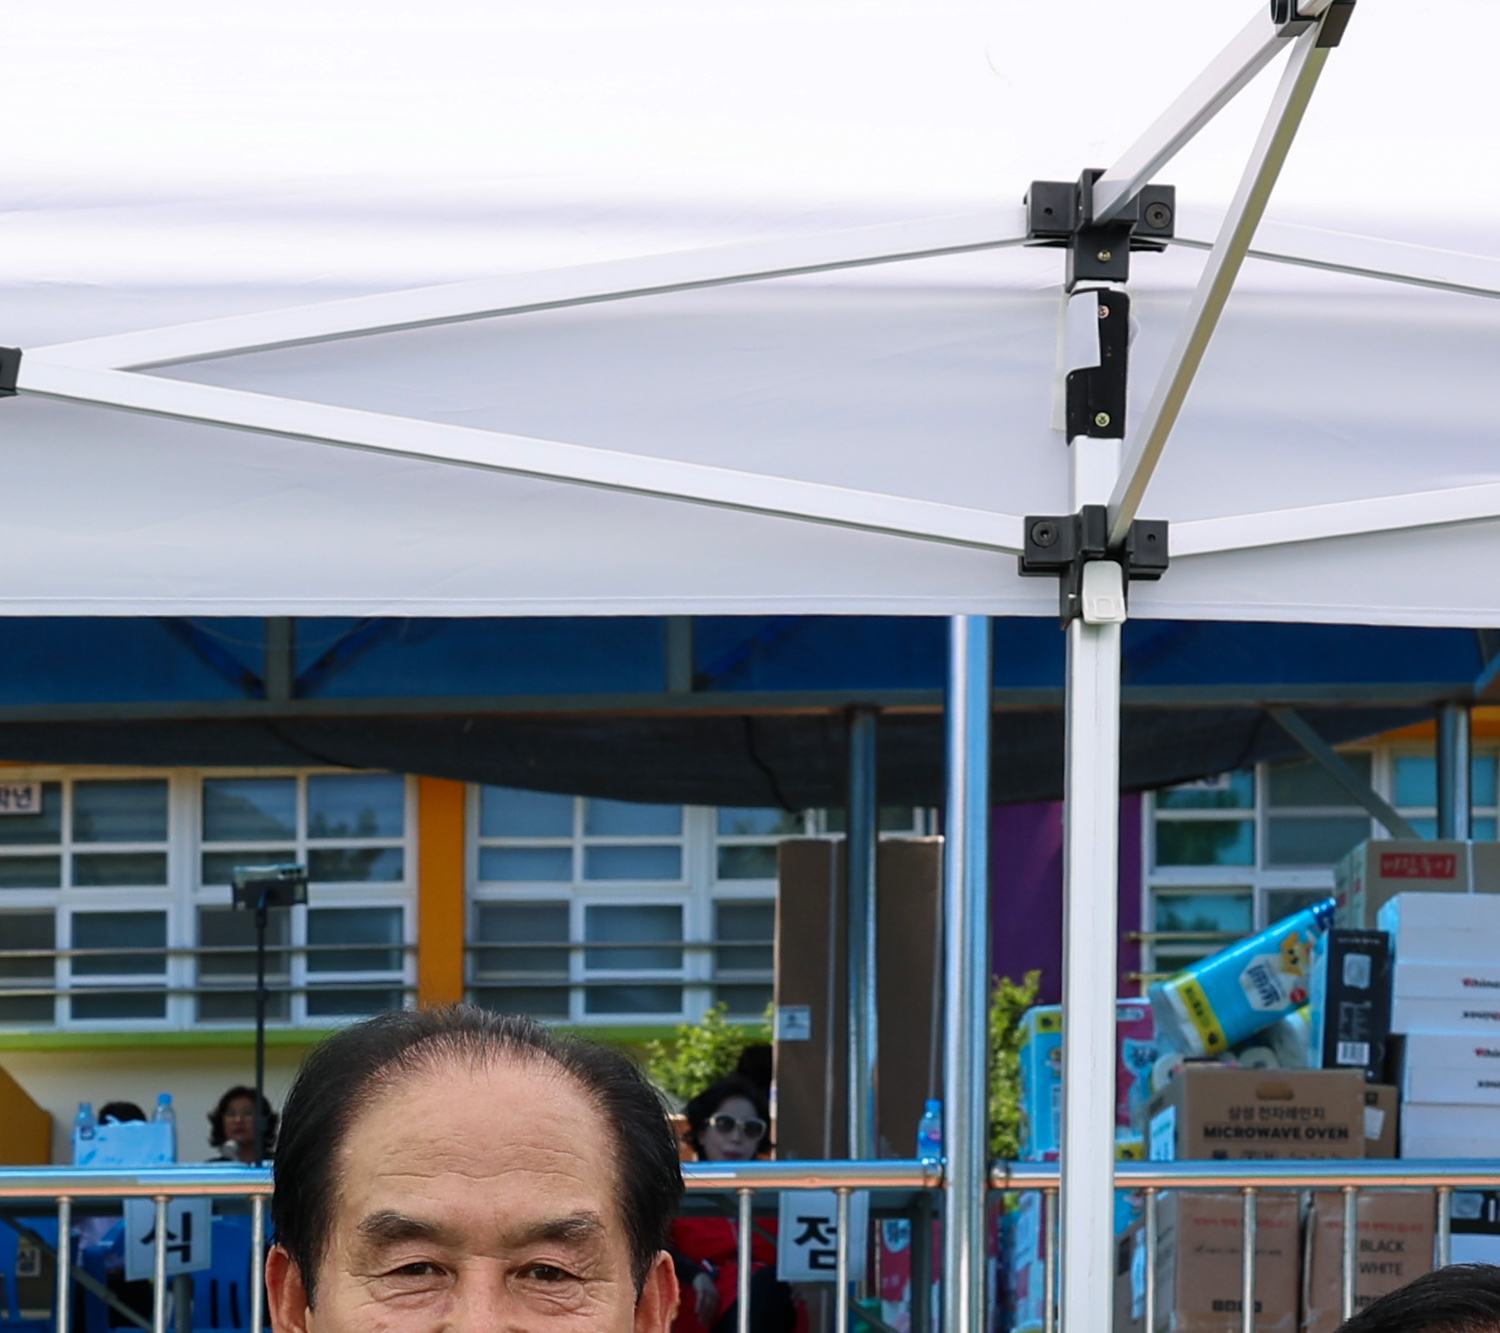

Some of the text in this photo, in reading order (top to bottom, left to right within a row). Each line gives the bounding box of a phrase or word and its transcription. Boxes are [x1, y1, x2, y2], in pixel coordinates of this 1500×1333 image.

[1203, 1126, 1349, 1140] MICROWAVE OVEN
[1360, 1239, 1404, 1253] BLACK
[1360, 1261, 1403, 1276] WHITE
